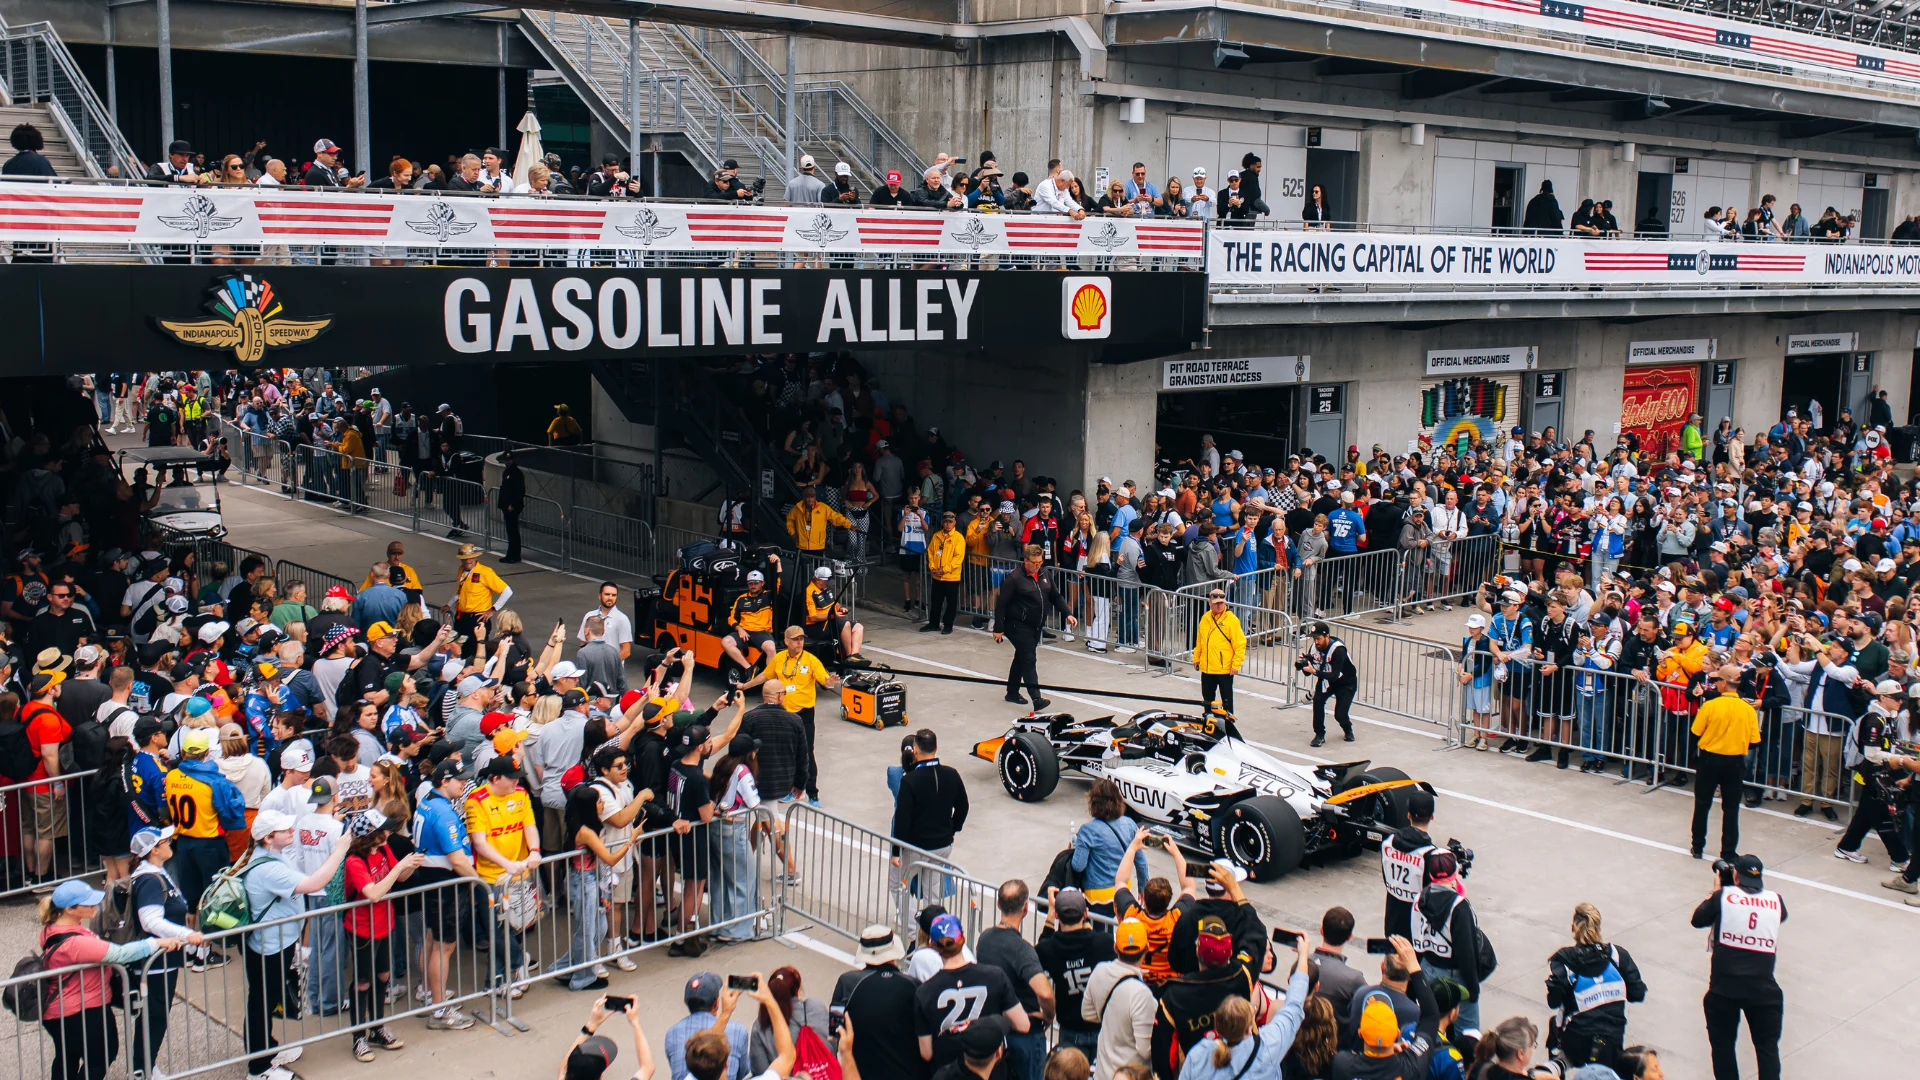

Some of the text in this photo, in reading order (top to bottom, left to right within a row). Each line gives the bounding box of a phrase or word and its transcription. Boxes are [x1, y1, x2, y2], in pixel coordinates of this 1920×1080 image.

[1282, 177, 1304, 198] 525
[1672, 190, 1686, 206] 526
[1671, 208, 1685, 223] 527
[1223, 242, 1555, 274] THE RACING CAPITAL OF THE WORLD
[1825, 252, 1893, 276] INDIANAPOLIS
[444, 277, 980, 353] GASOLINE ALLEY
[183, 329, 238, 338] INDIANAPOLIS
[251, 314, 262, 356] MOTOR
[270, 328, 310, 337] SPEEDWAY
[1633, 346, 1695, 356] OFFICIAL MERCHANDISE
[1791, 338, 1840, 348] OFFICIAL MERCHANDISE
[1170, 360, 1250, 374] PIT ROAD TERRACE
[1431, 354, 1510, 367] OFFICIAL MERCHANDISE
[1169, 372, 1262, 386] GRANDSTAND ACCESS
[1718, 374, 1726, 384] 27
[1543, 386, 1553, 396] 26
[1319, 400, 1331, 413] 25
[1656, 387, 1688, 421] 500
[853, 694, 862, 714] 5
[1204, 718, 1218, 735] 5
[1107, 774, 1166, 809] RROW
[1238, 768, 1295, 798] VELO
[170, 794, 197, 829] 10
[491, 820, 524, 837] DHL
[1384, 846, 1421, 867] Canon
[1390, 863, 1410, 885] 172
[1386, 882, 1418, 899] PHOTO
[1726, 893, 1777, 910] Canon
[1748, 912, 1758, 930] 6
[1722, 931, 1774, 948] PHOTO
[1063, 966, 1092, 996] 15
[937, 986, 988, 1036] 27
